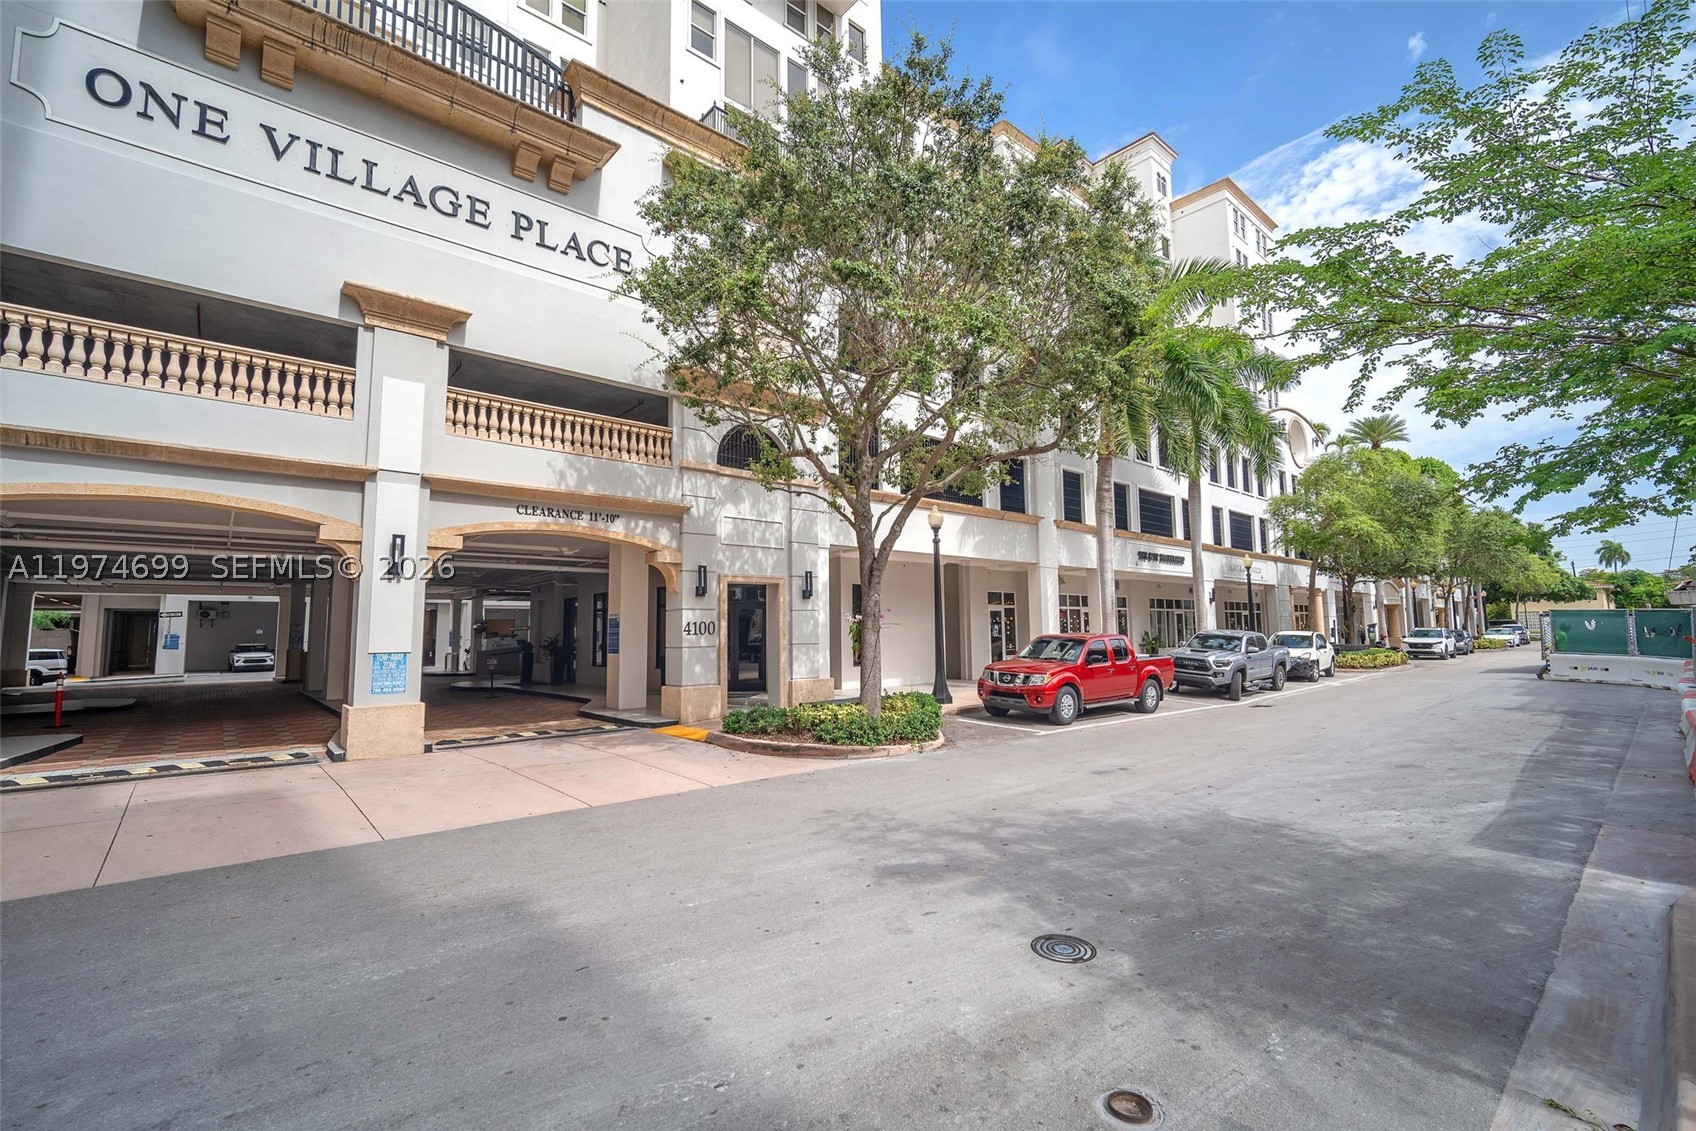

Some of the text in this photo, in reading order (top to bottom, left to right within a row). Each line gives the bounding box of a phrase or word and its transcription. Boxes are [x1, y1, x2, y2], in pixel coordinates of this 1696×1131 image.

[85, 67, 634, 275] ONE VILLAGE PLACE
[516, 504, 584, 520] CLEARANCE
[683, 620, 716, 636] 4100
[382, 661, 398, 669] ZONE
